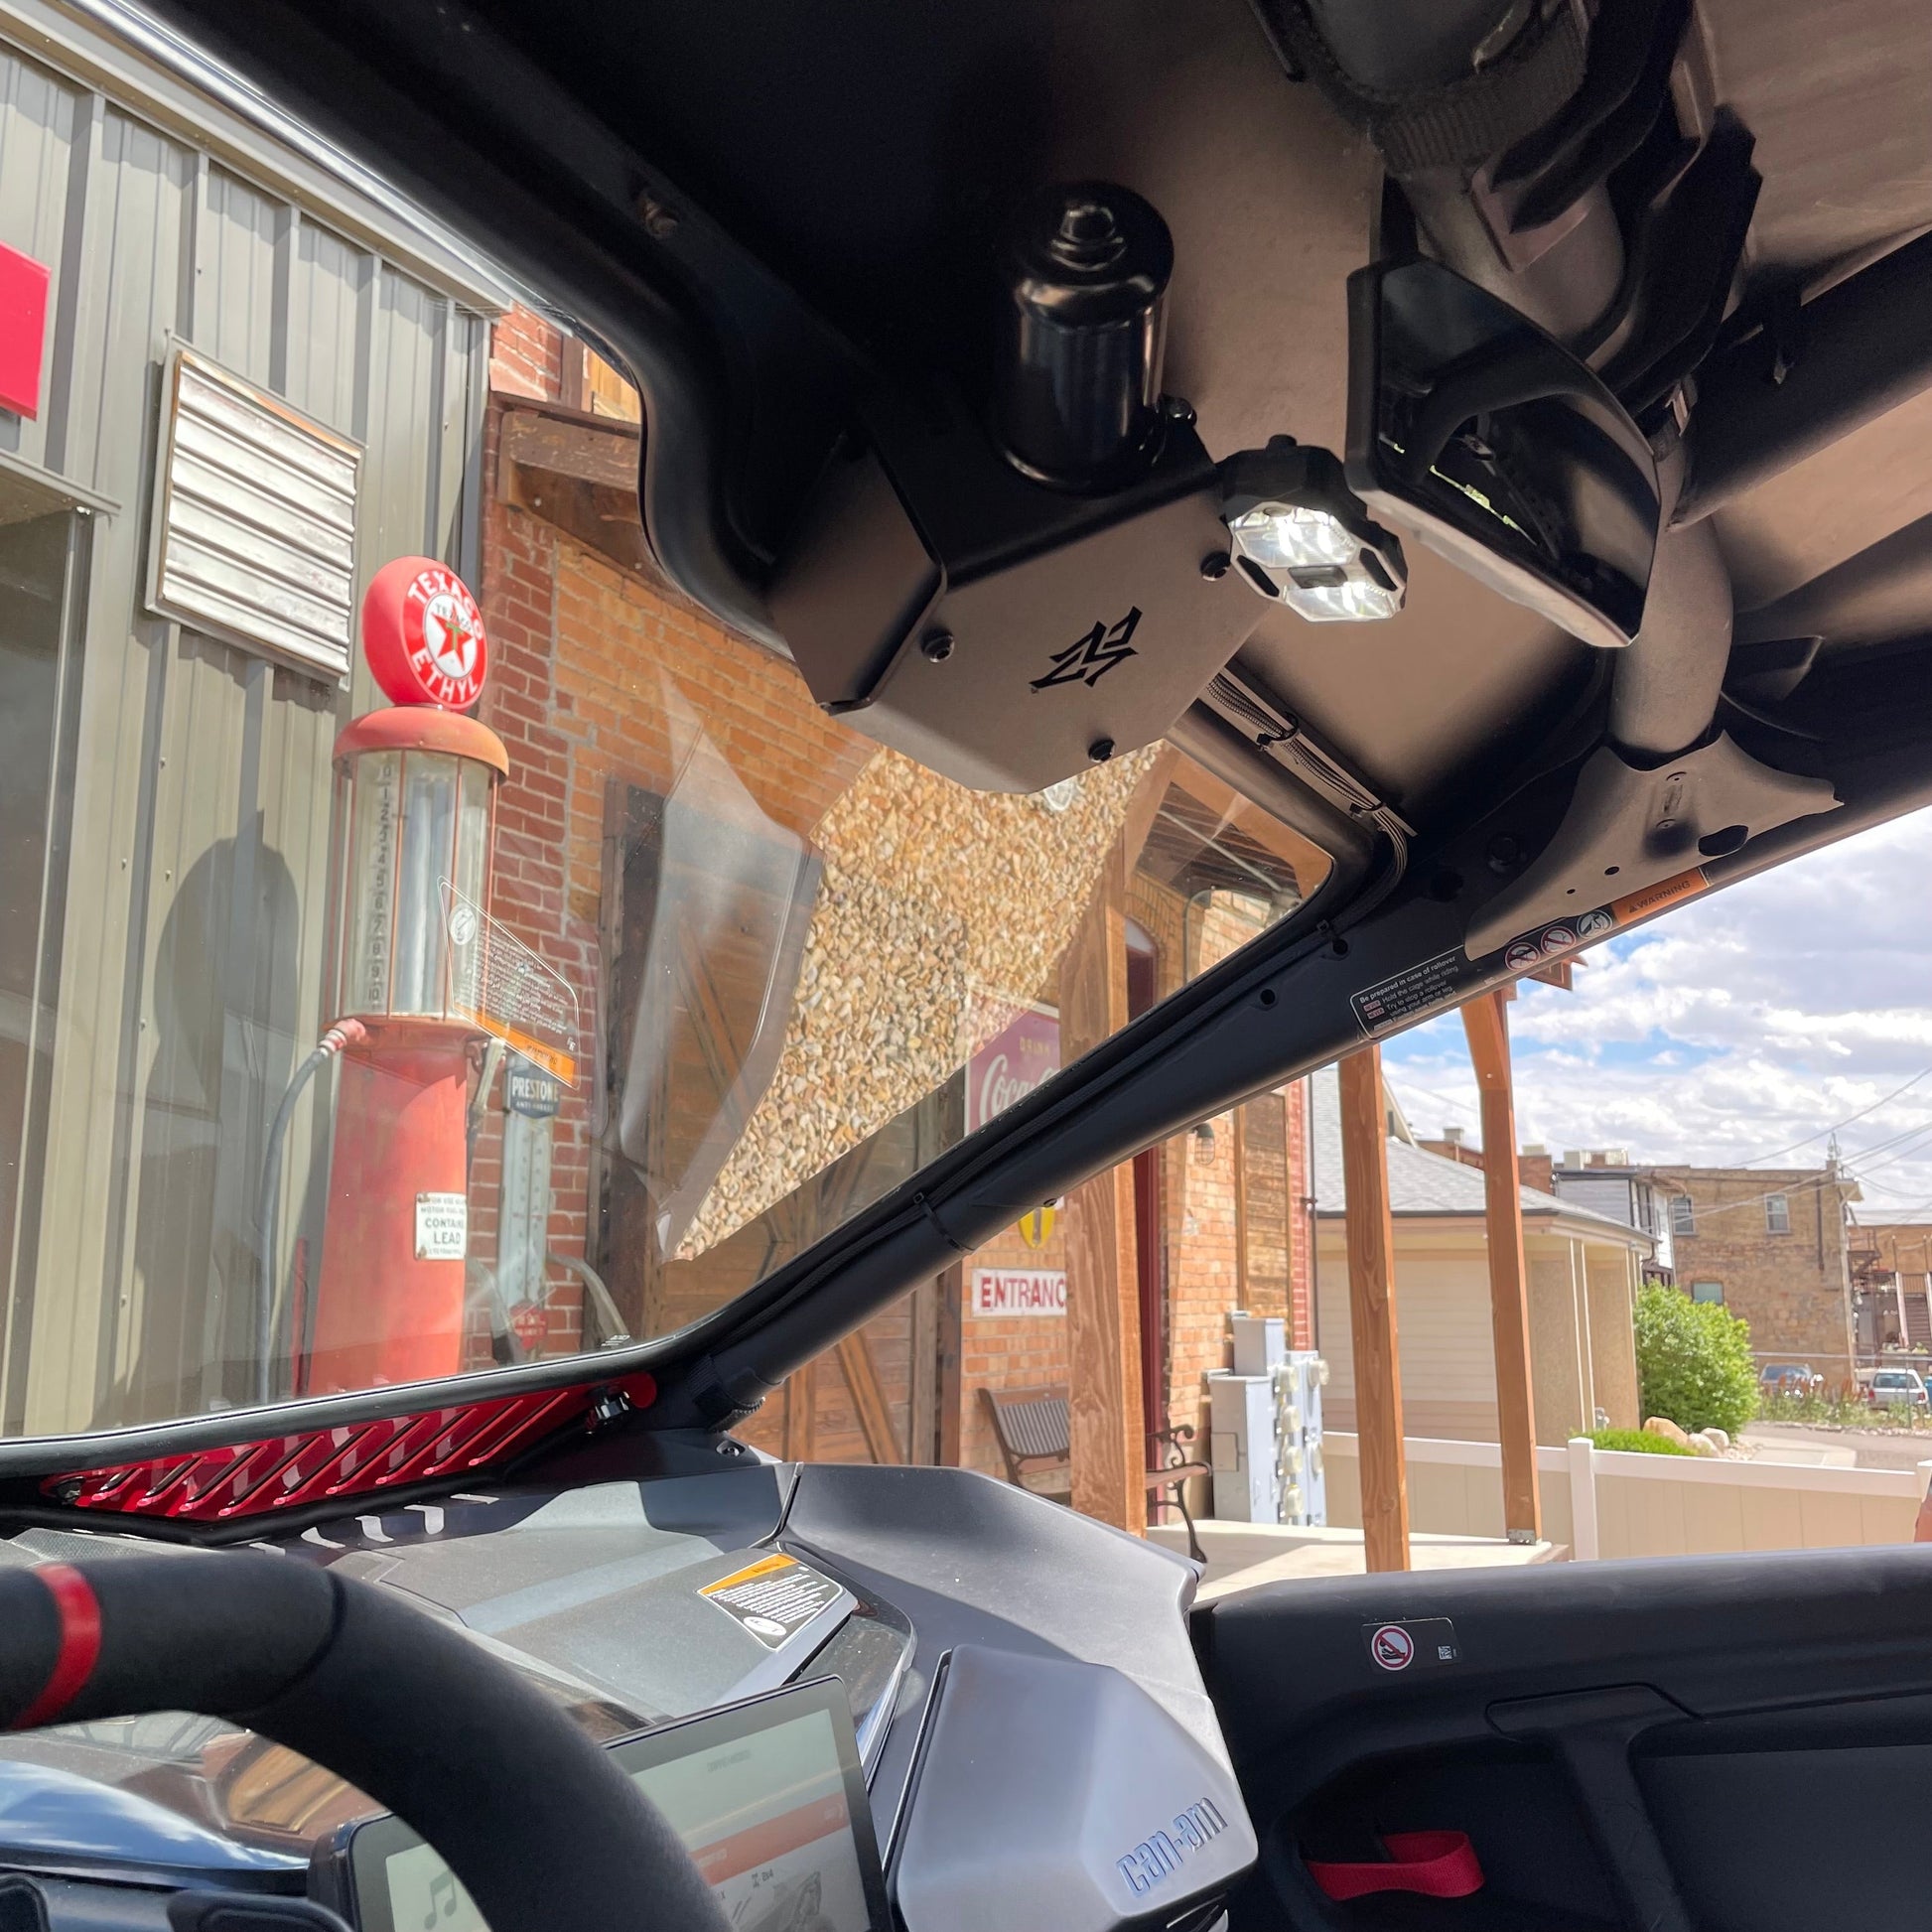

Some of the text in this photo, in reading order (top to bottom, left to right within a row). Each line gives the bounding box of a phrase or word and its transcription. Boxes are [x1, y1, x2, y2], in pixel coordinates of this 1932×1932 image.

[407, 570, 483, 640] TEXACO
[411, 647, 478, 702] ETHYL
[1636, 880, 1691, 908] WARNING
[1359, 995, 1370, 1004] Be
[1369, 981, 1399, 1001] prepared
[1407, 971, 1423, 982] case
[1423, 966, 1431, 975] of
[1431, 956, 1456, 971] rollover
[1382, 992, 1397, 1003] Hold
[1397, 987, 1408, 997] the
[1409, 982, 1424, 993] cage
[1425, 980, 1447, 993] rollover
[512, 1075, 559, 1102] PRESTONE
[434, 1230, 462, 1245] LEAD
[981, 1277, 1065, 1308] ENTRANC
